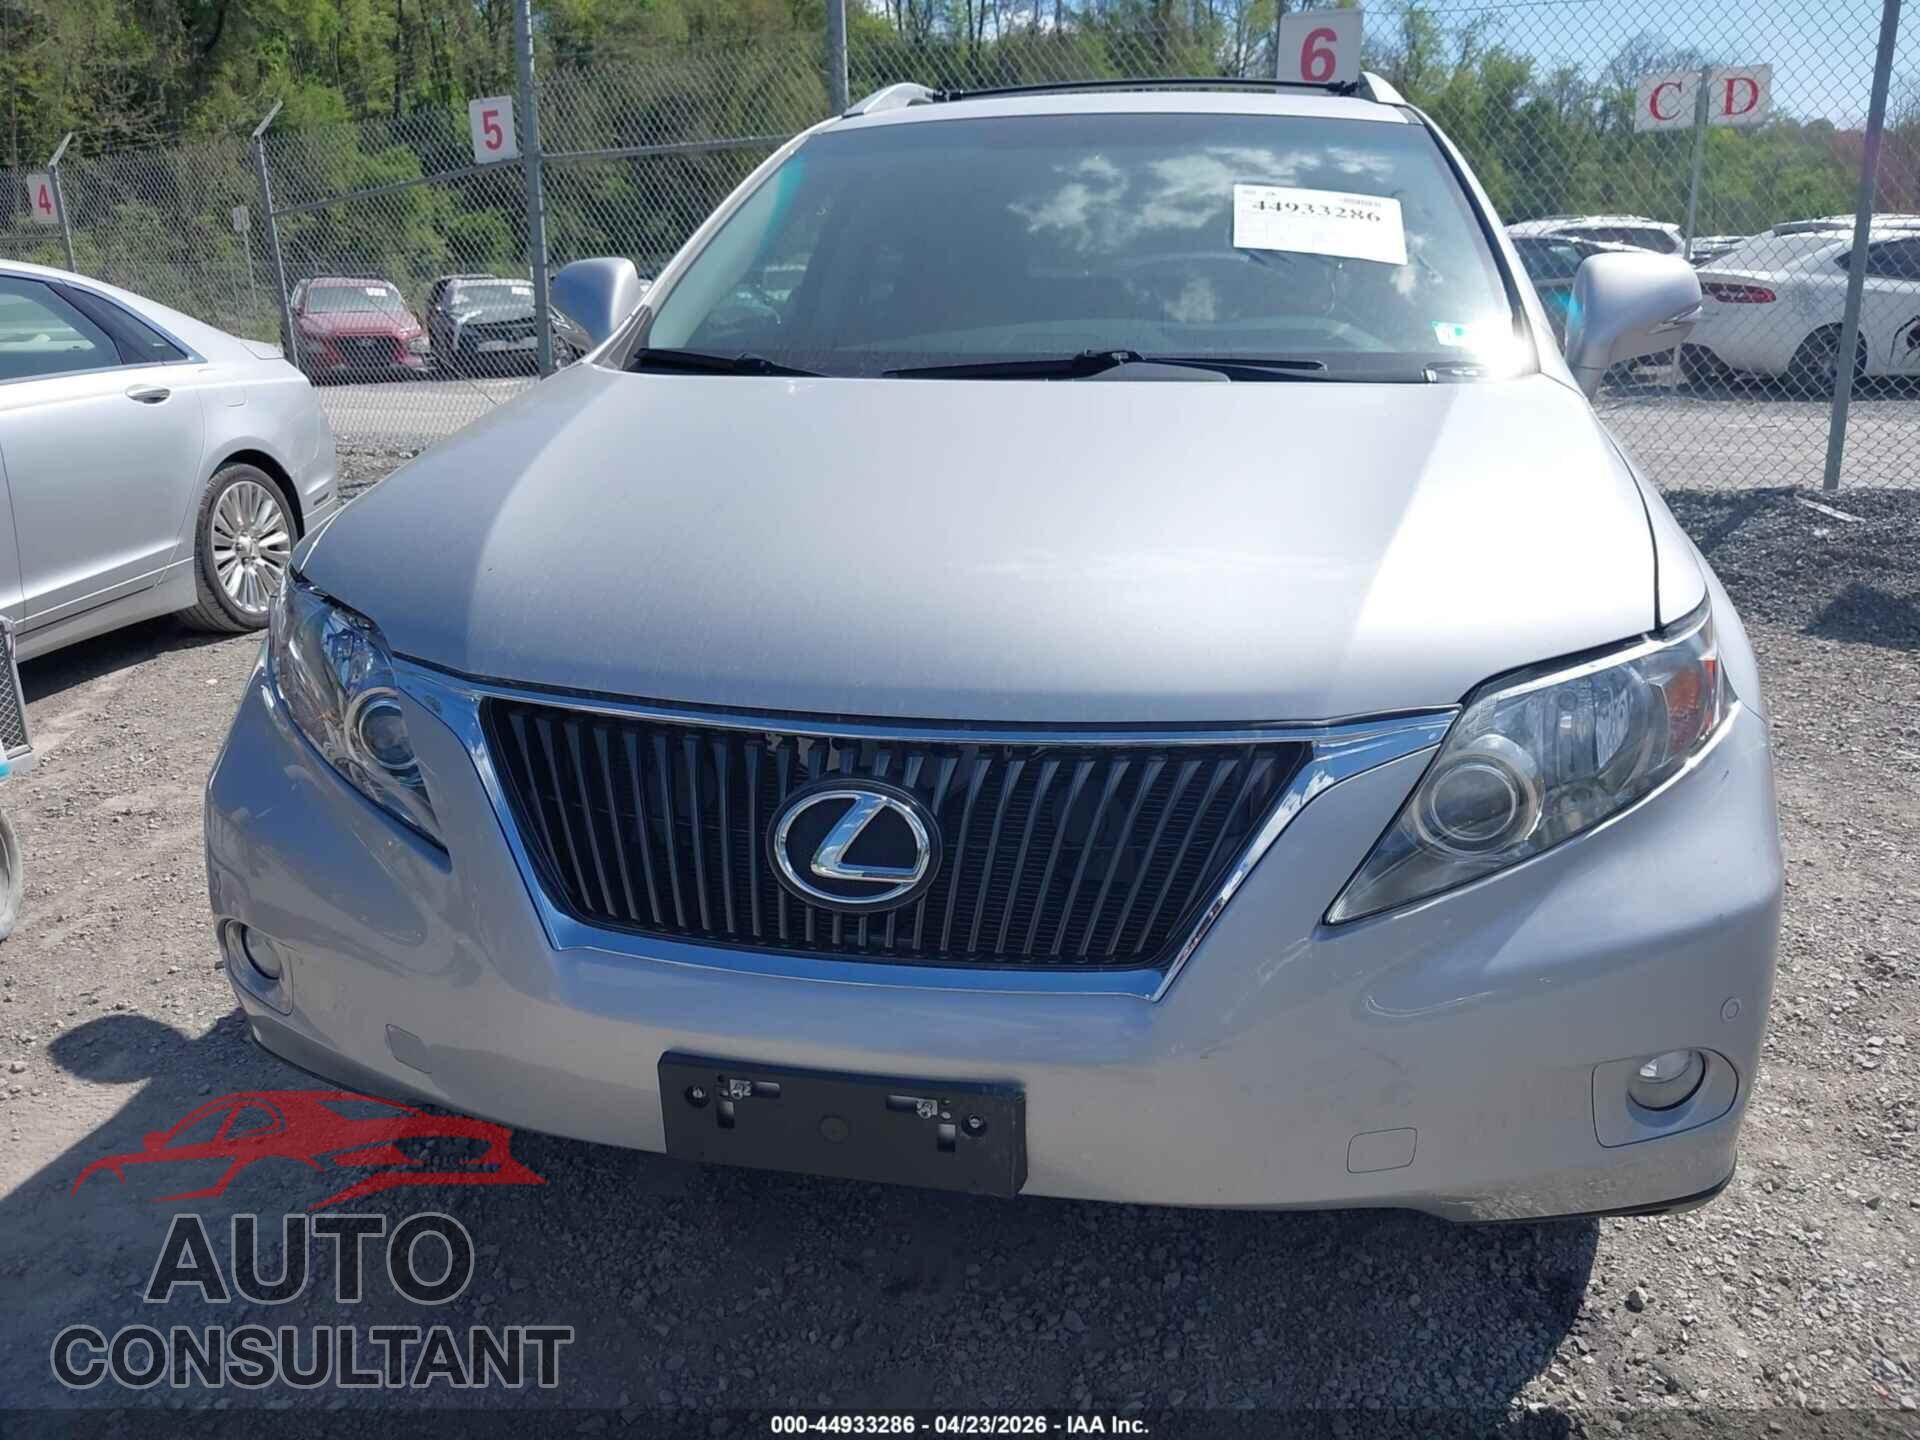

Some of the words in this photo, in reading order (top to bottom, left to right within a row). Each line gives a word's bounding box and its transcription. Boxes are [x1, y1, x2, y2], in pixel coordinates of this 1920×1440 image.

[1301, 27, 1337, 82] 6
[1649, 80, 1682, 121] C
[1721, 76, 1760, 116] D
[482, 109, 504, 151] 5
[39, 183, 52, 215] 4
[1251, 199, 1382, 223] 44933286
